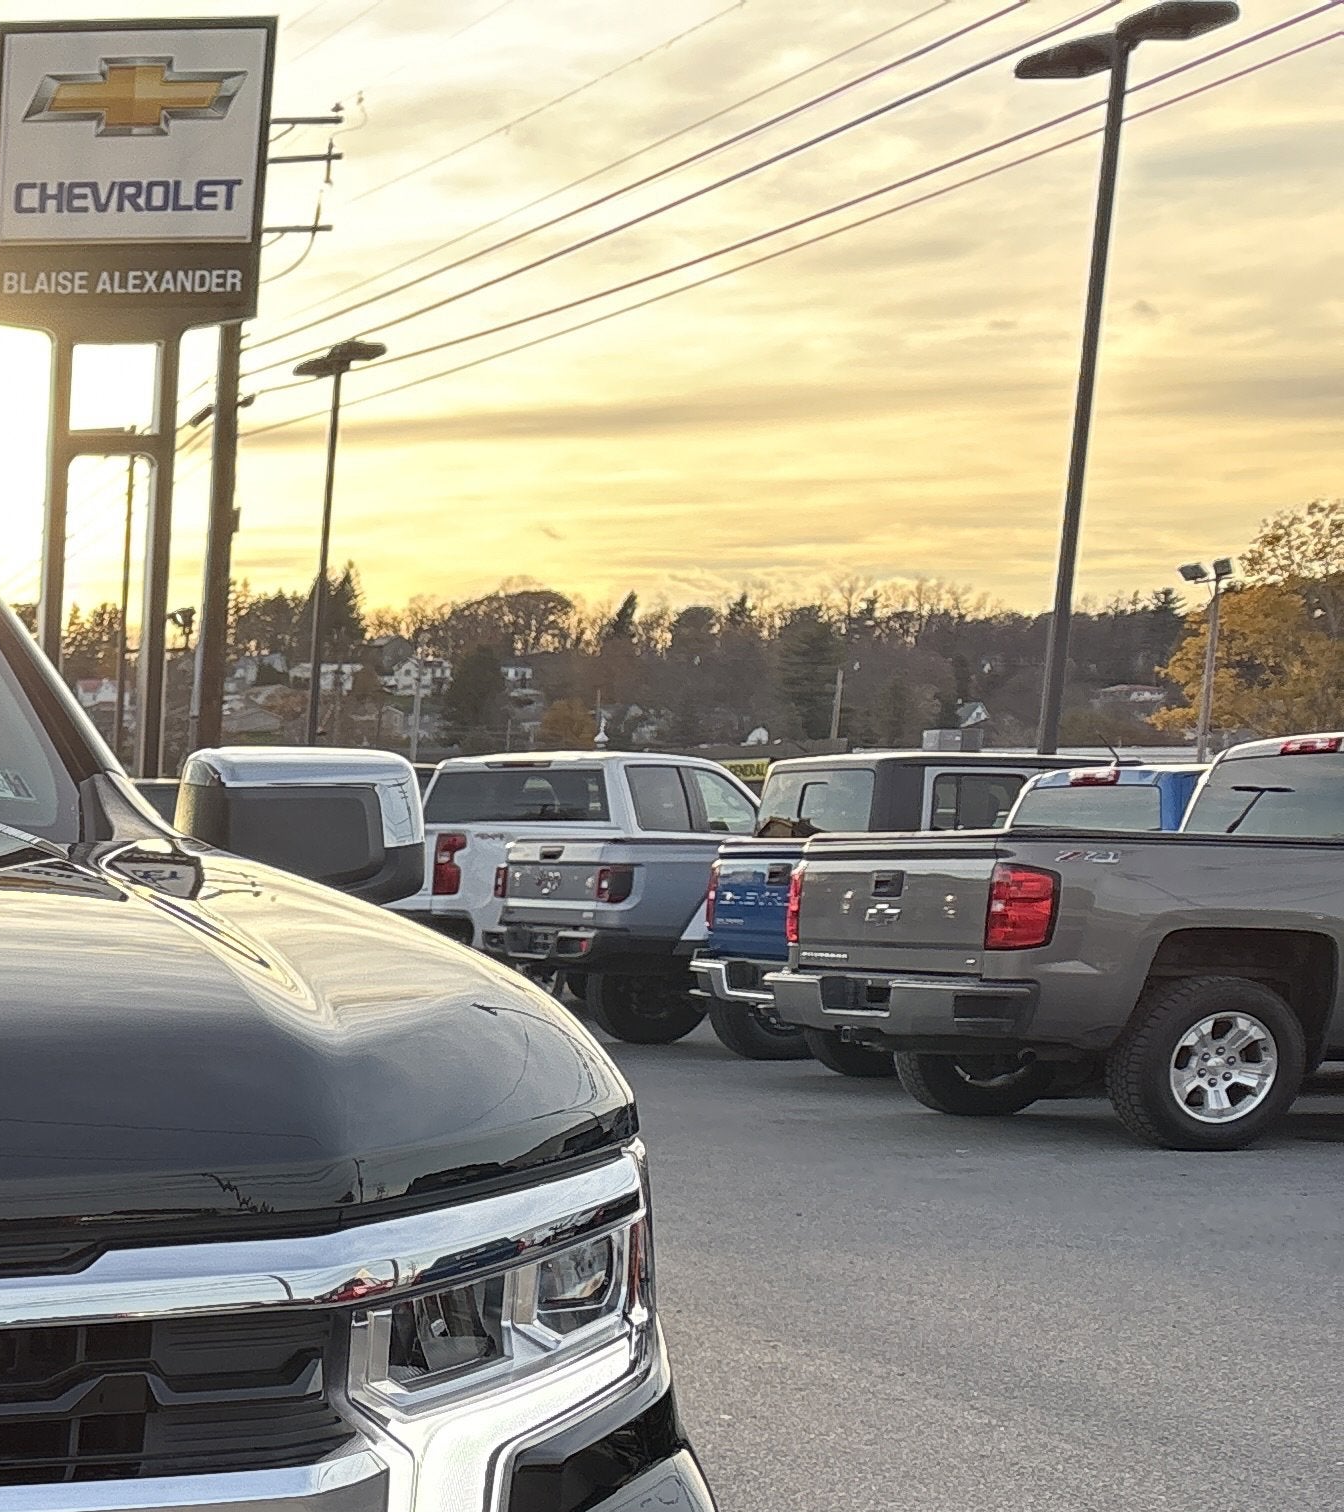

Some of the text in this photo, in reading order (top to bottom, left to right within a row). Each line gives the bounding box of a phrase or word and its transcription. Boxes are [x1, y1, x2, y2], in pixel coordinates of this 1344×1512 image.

[14, 179, 243, 214] CHEVROLET
[2, 269, 243, 295] BLAISE ALEXANDER
